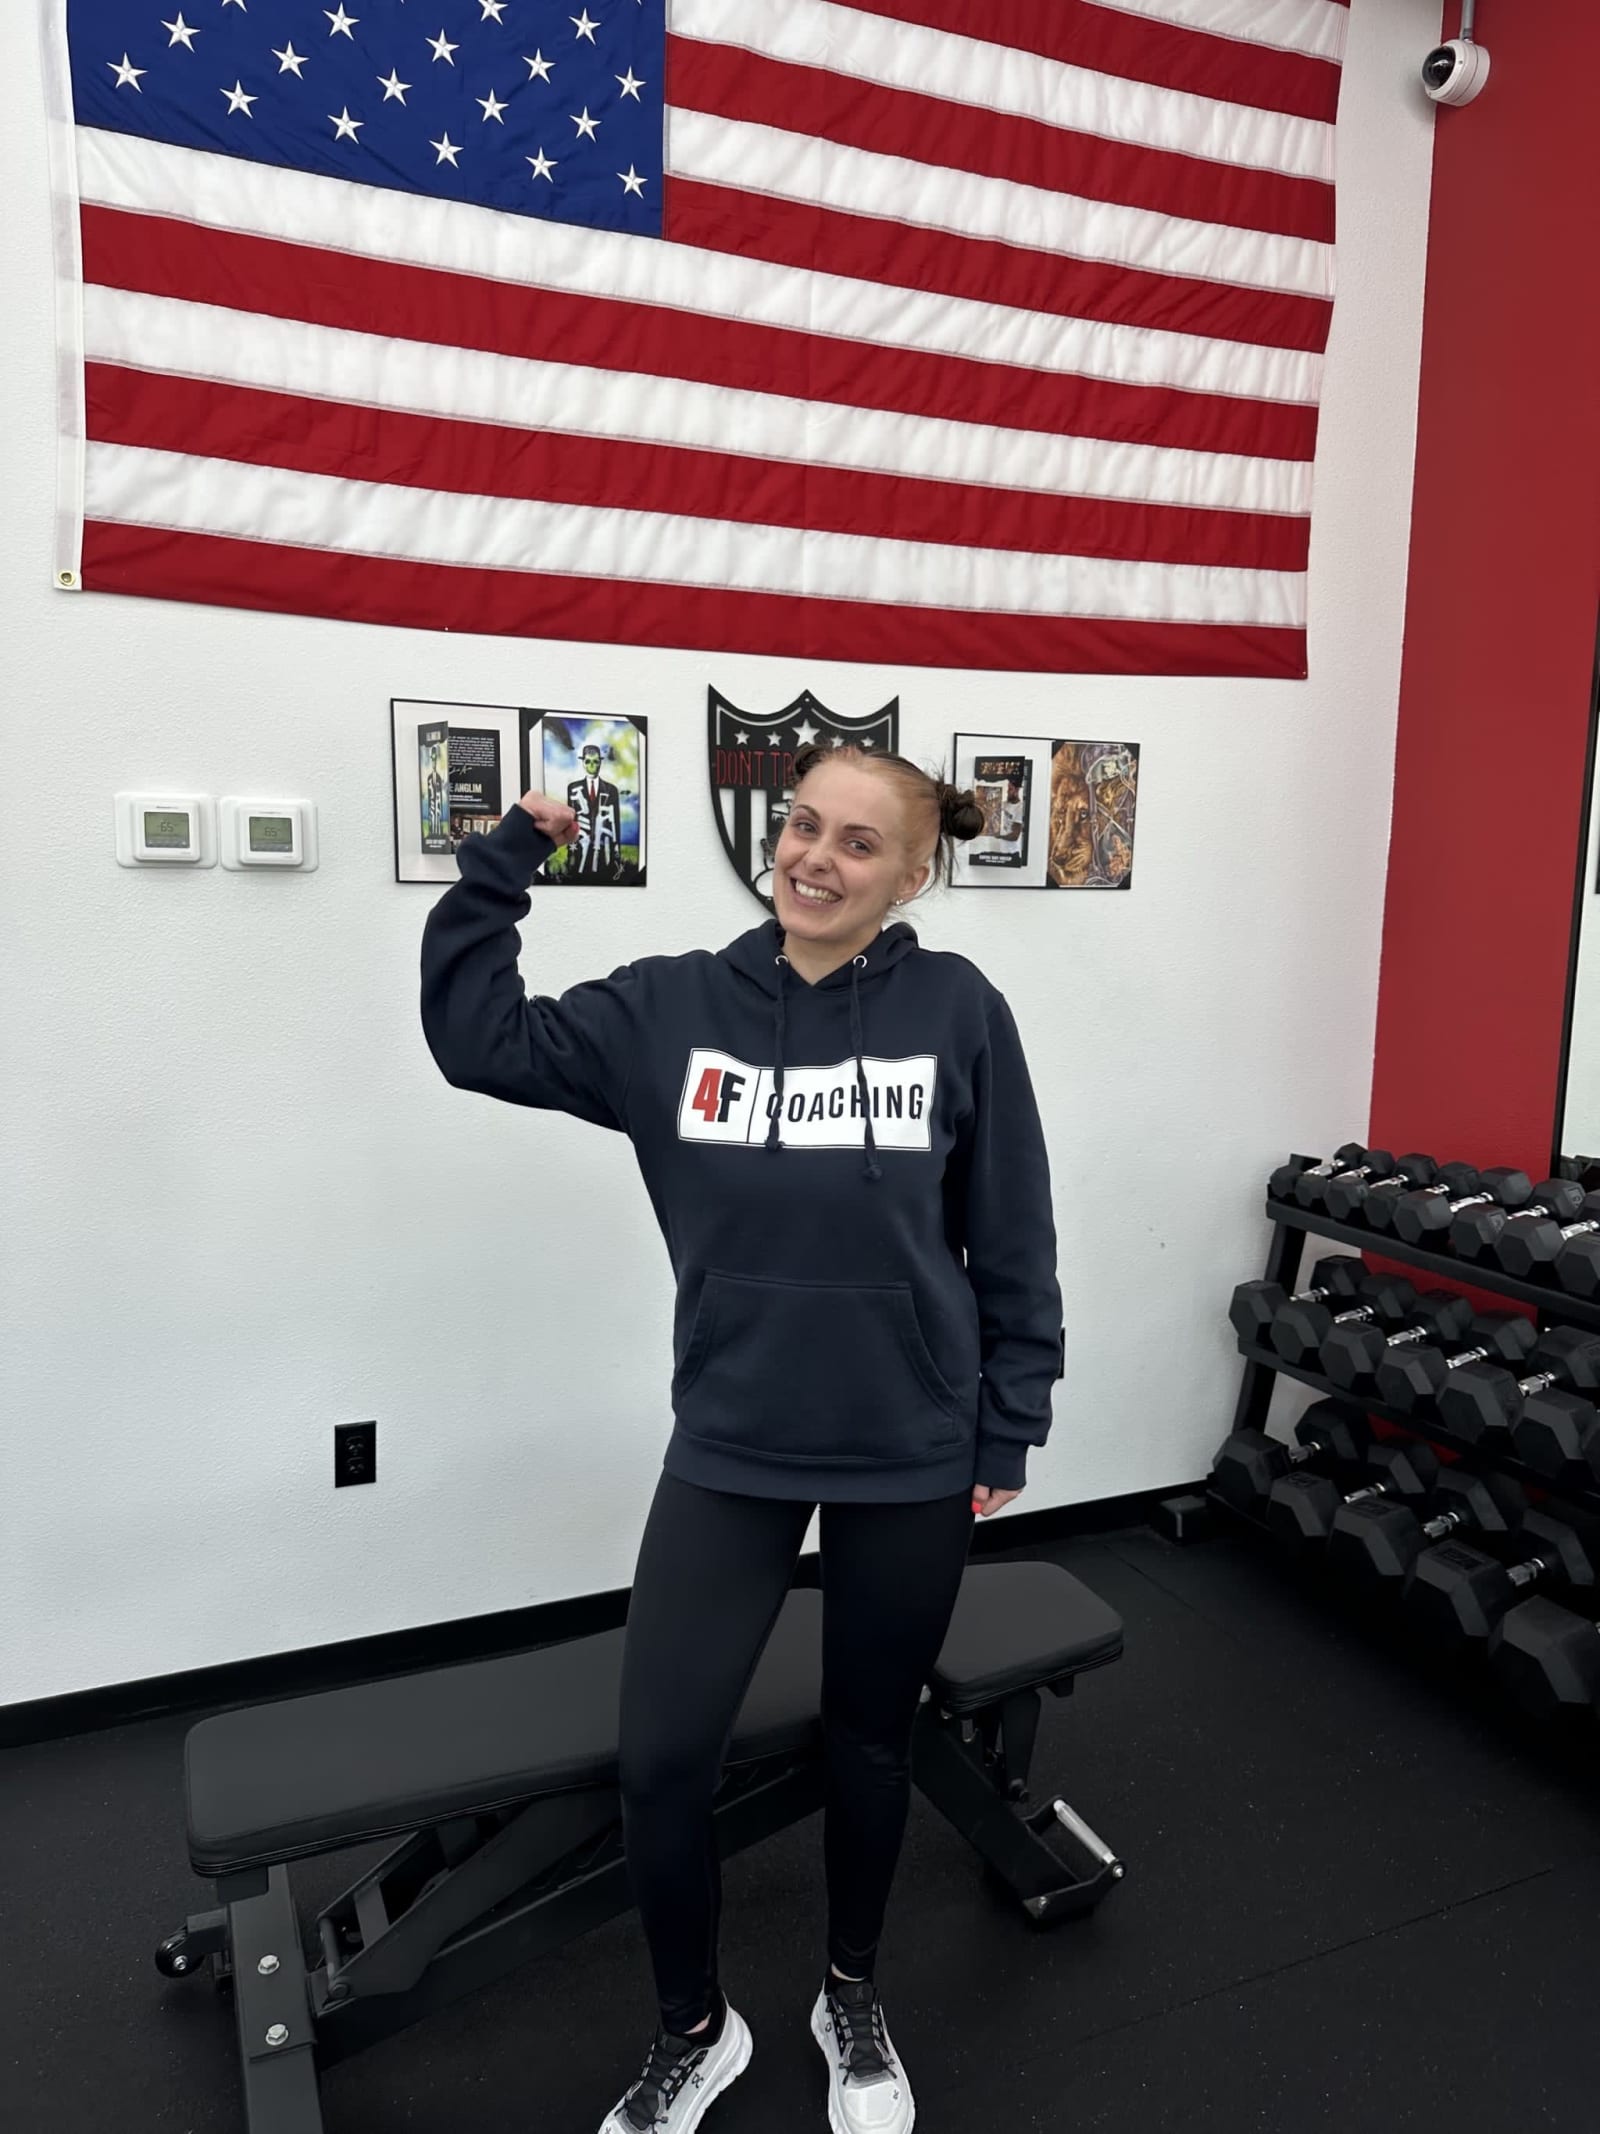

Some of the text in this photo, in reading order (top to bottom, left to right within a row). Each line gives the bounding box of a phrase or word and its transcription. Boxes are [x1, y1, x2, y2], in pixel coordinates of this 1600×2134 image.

[715, 749, 764, 786] DONT
[454, 783, 482, 793] ANGLIM
[691, 1067, 924, 1123] 4F COACHING
